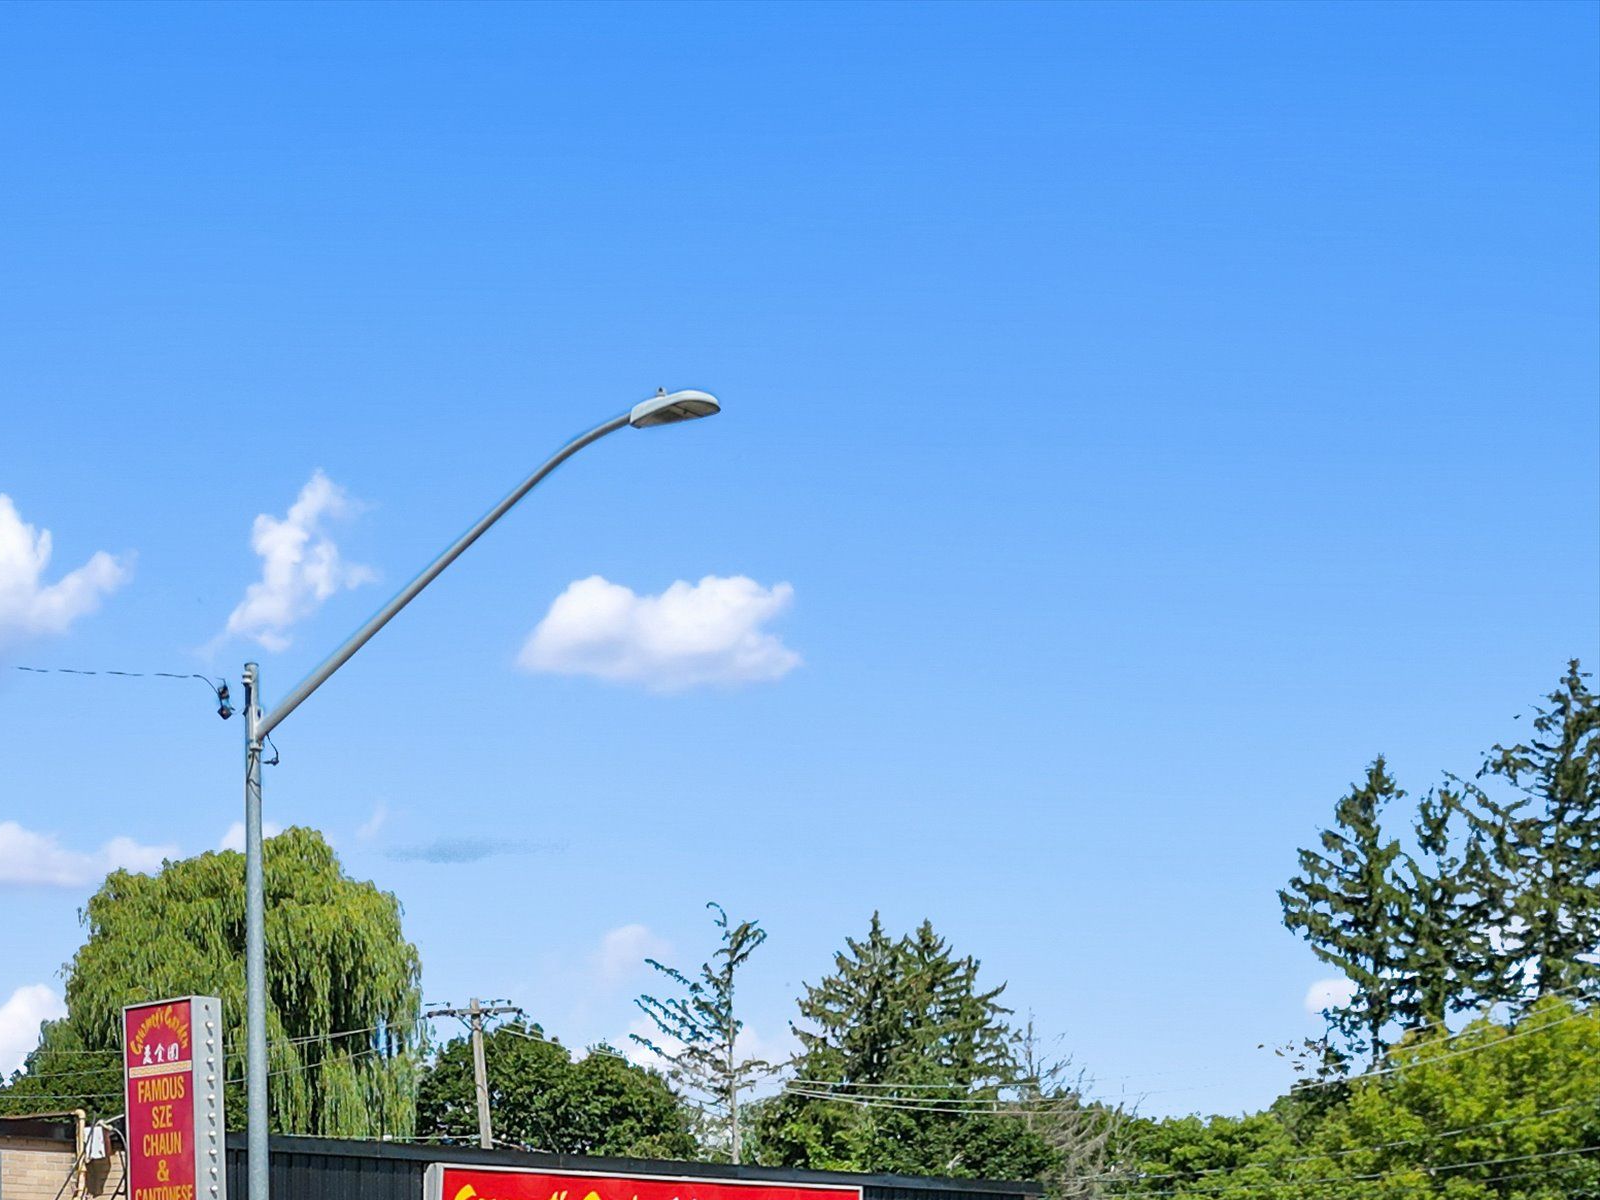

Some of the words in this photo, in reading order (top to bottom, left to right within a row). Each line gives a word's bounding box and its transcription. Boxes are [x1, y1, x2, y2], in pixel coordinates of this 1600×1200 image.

[137, 1075, 185, 1104] FAMOUS
[151, 1104, 173, 1129] SZE
[143, 1131, 182, 1157] CHAUN
[157, 1159, 170, 1182] &
